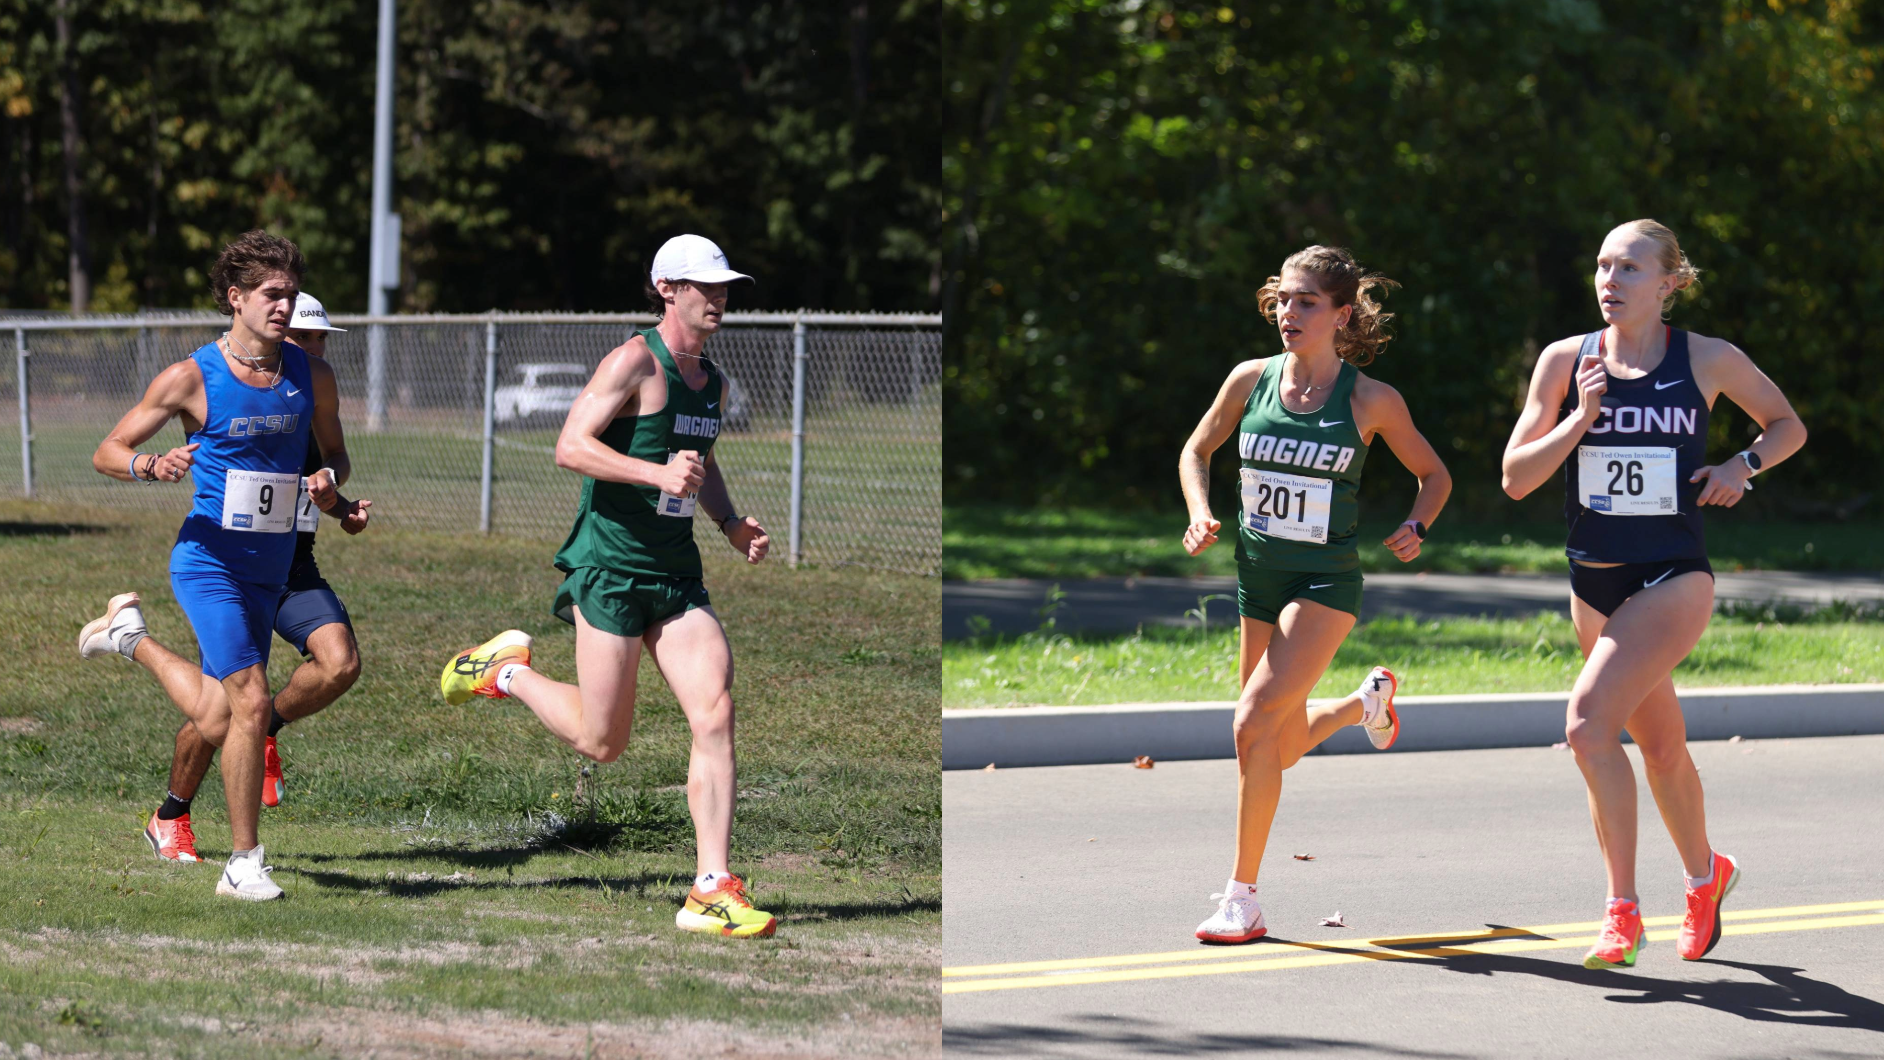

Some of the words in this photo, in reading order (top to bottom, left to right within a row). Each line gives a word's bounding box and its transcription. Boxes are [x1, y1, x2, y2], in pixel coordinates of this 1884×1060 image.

[228, 414, 299, 437] CCSU
[1570, 406, 1697, 435] CONN
[1239, 432, 1355, 473] WAGNER
[1273, 477, 1290, 486] Owen
[1291, 480, 1327, 490] Invitational
[1607, 460, 1644, 496] 26
[258, 484, 274, 515] 9
[1257, 483, 1306, 523] 201
